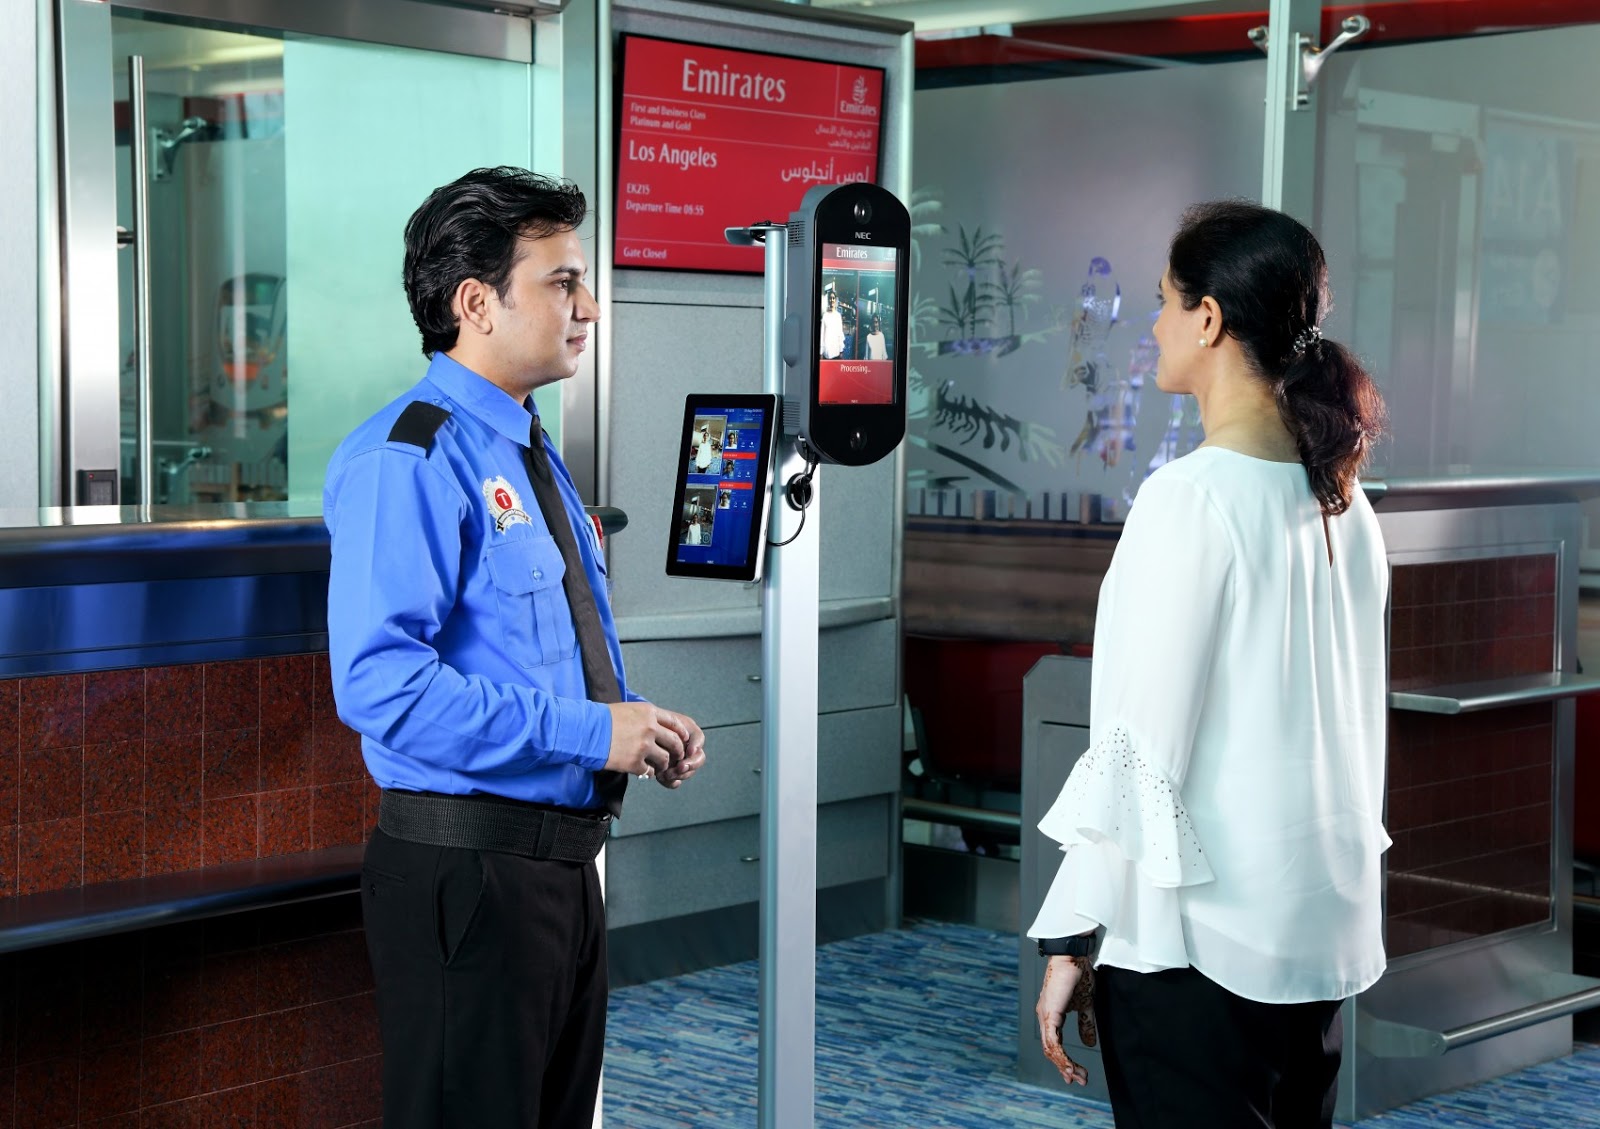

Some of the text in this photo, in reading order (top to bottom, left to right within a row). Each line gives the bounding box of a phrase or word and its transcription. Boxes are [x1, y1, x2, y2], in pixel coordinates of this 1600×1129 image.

[682, 59, 786, 102] Emirates
[631, 102, 706, 120] First and Business Class
[840, 100, 877, 116] Emirates
[630, 115, 691, 131] Platinum and Gold
[629, 140, 717, 171] Los Angeles
[626, 183, 650, 195] EK215
[625, 199, 662, 214] Departure
[664, 202, 682, 214] Time
[854, 231, 871, 240] NEC
[623, 247, 667, 260] Gate Closed
[836, 247, 868, 259] Emirates
